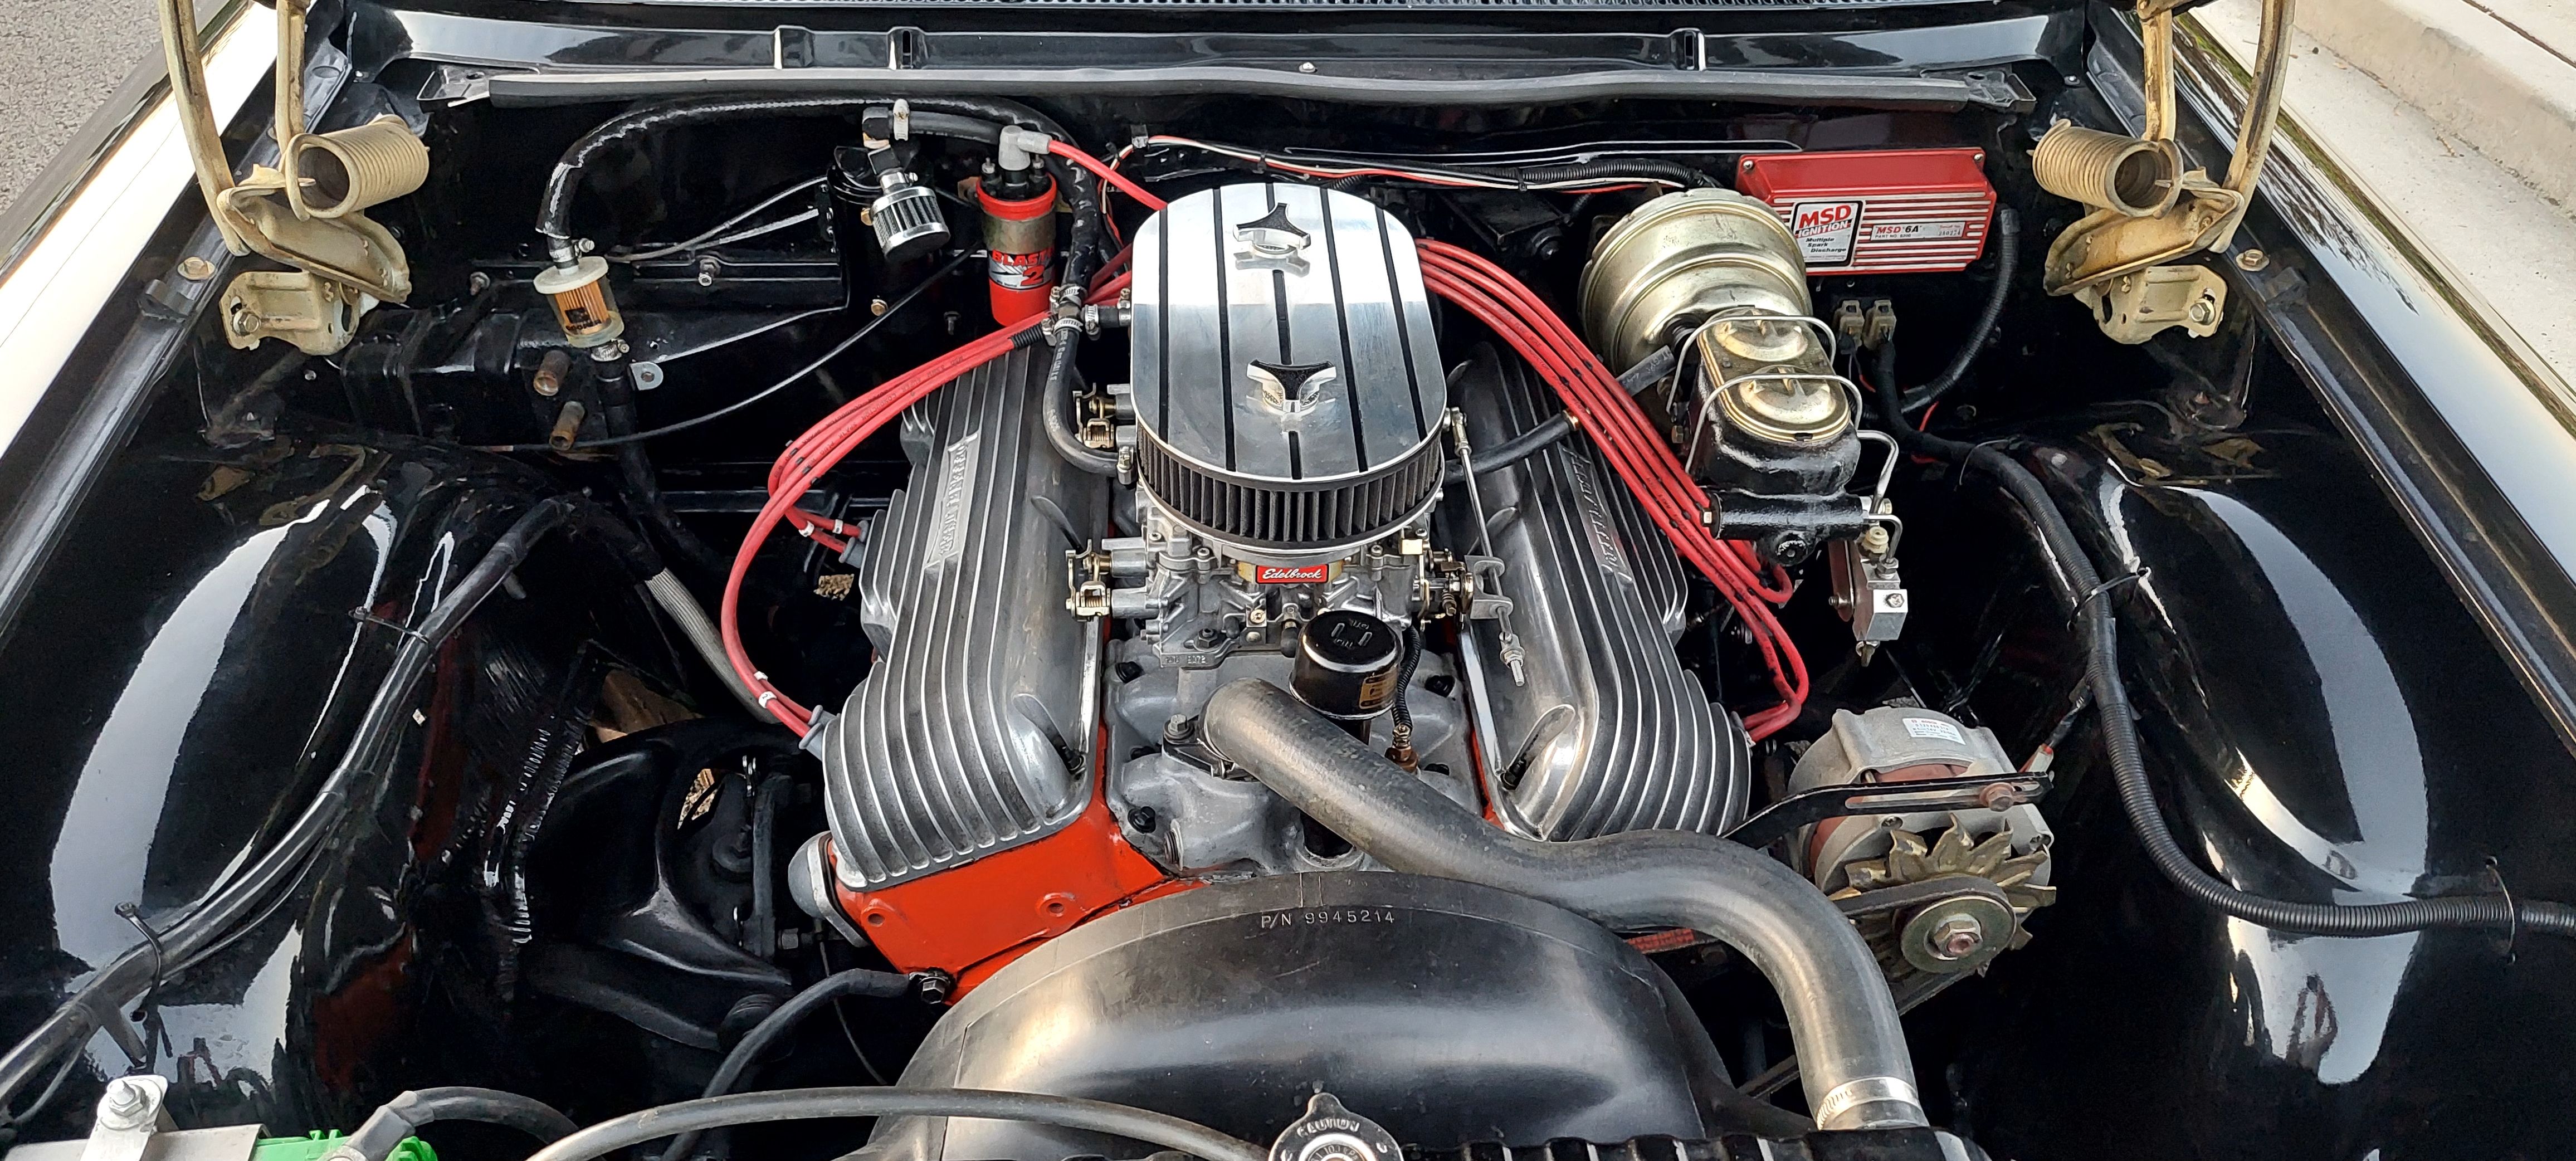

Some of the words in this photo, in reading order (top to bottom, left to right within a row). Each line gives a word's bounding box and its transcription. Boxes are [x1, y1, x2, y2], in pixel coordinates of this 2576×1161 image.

[1799, 205, 1852, 229] MSD
[1798, 221, 1848, 238] IGNITION
[1877, 226, 1901, 235] MSD
[1021, 265, 1046, 287] 2
[862, 392, 897, 421] CONDUCTOR
[838, 422, 858, 440] SPARK
[819, 441, 835, 456] PLUG
[1262, 568, 1322, 579] Edelbrock
[1261, 912, 1292, 929] P/N
[1305, 909, 1395, 924] 9945214
[1296, 1118, 1360, 1137] CAUTION
